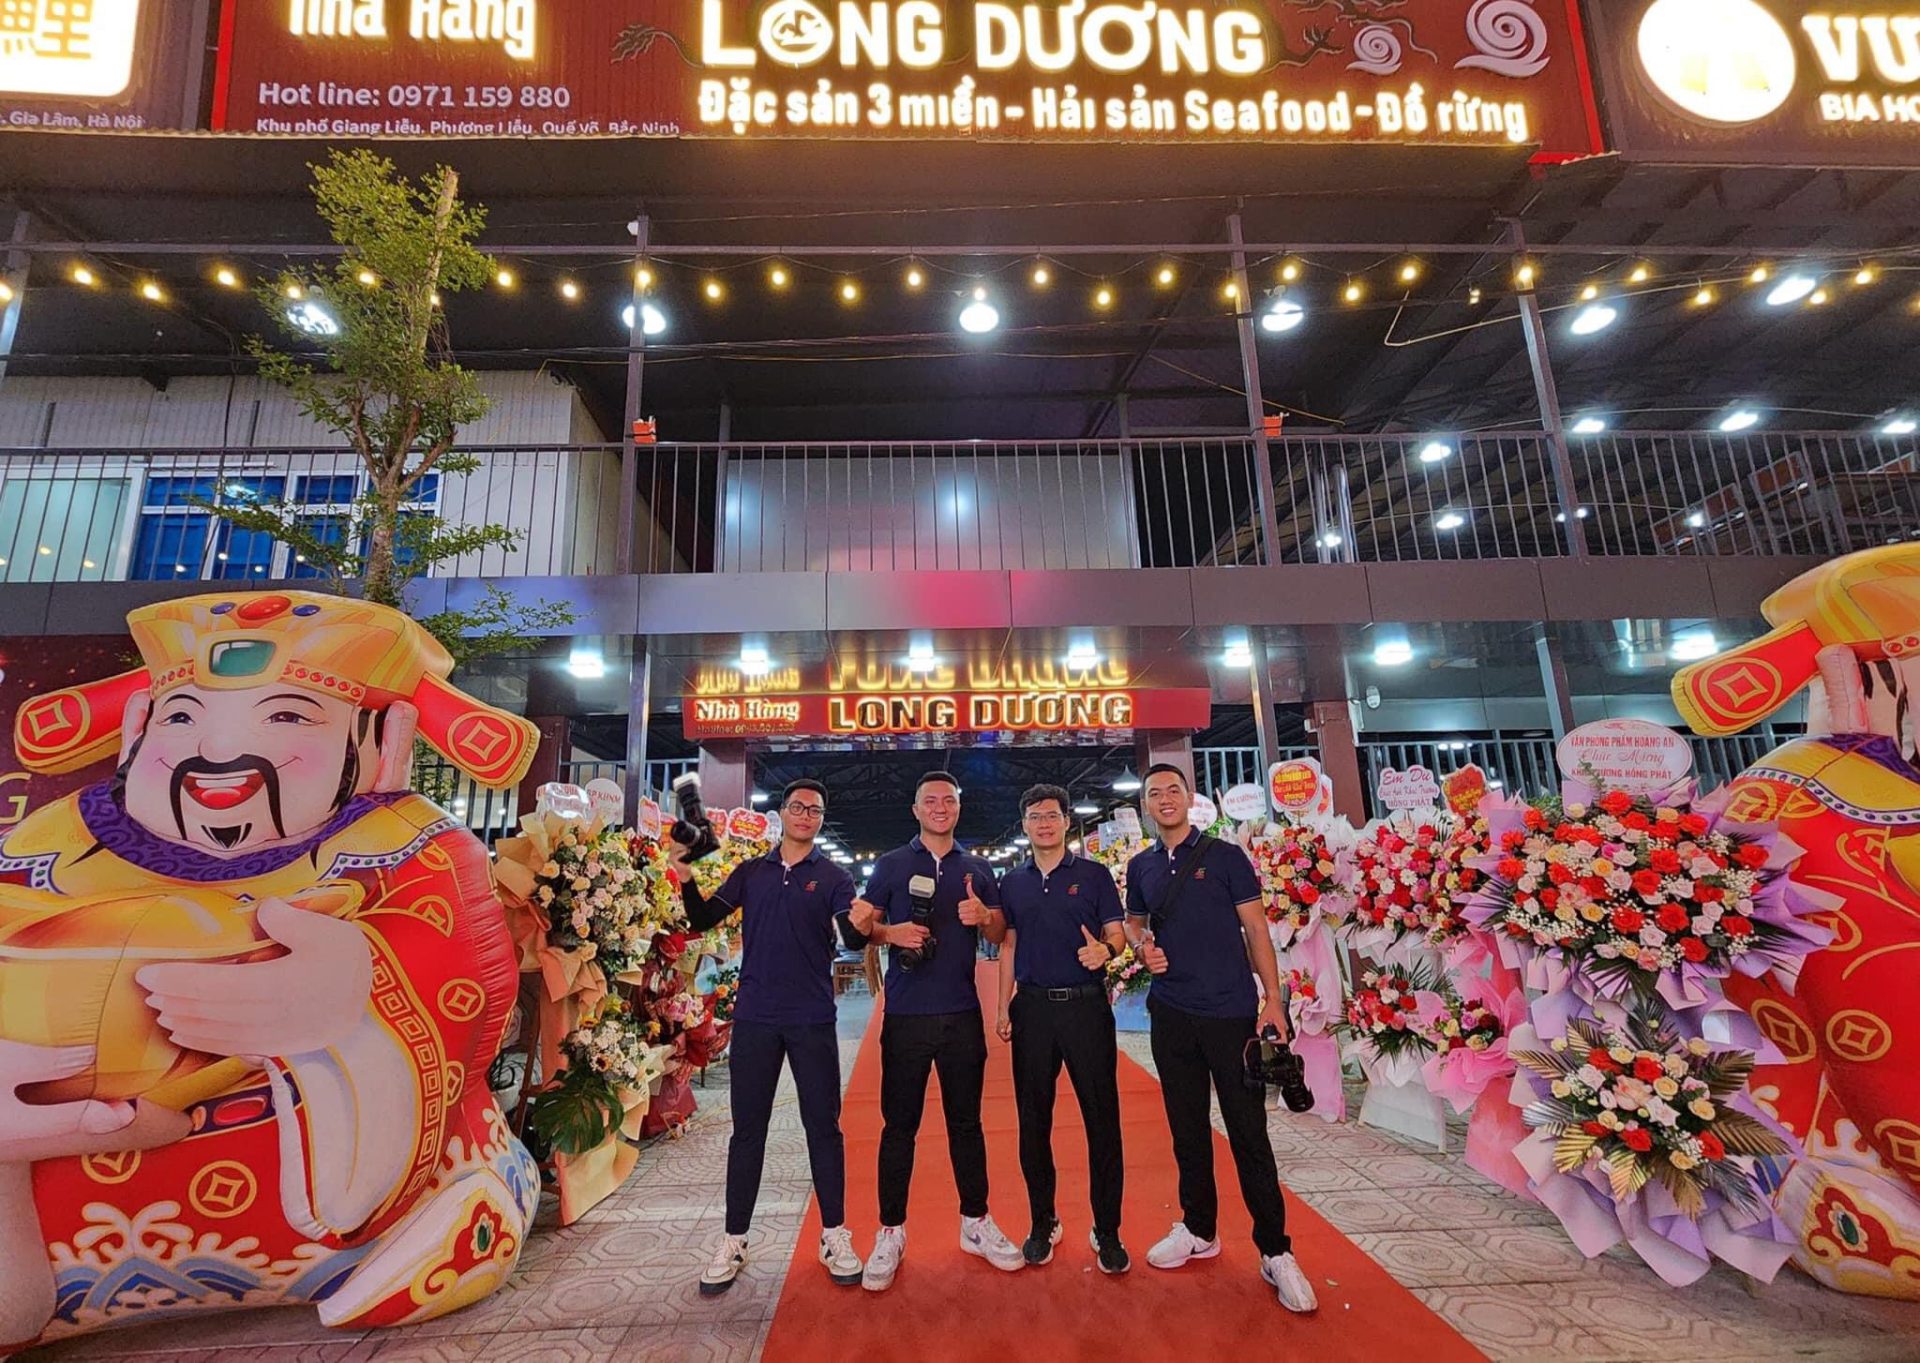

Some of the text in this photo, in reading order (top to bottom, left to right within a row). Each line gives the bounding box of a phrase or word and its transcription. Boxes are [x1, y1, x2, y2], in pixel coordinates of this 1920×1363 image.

[701, 0, 1266, 74] LONG DƯƠNG
[258, 81, 571, 108] Hot line: 0971 159 880
[1819, 93, 1880, 122] BIA
[9, 110, 40, 126] Gia
[87, 113, 112, 128] Hà
[699, 77, 778, 135] Đặc
[786, 78, 858, 125] sản
[867, 83, 893, 126] 3
[1032, 84, 1097, 129] Hải
[1105, 84, 1176, 131] sản
[1185, 90, 1351, 132] Seafood
[1376, 82, 1428, 132] Đồ
[1438, 90, 1529, 142] rừng
[256, 118, 291, 133] Khu
[331, 118, 382, 135] Giang
[641, 121, 680, 134] Ninh
[694, 698, 800, 724] Nhà Hàng
[828, 690, 1134, 734] LONG DƯƠNG
